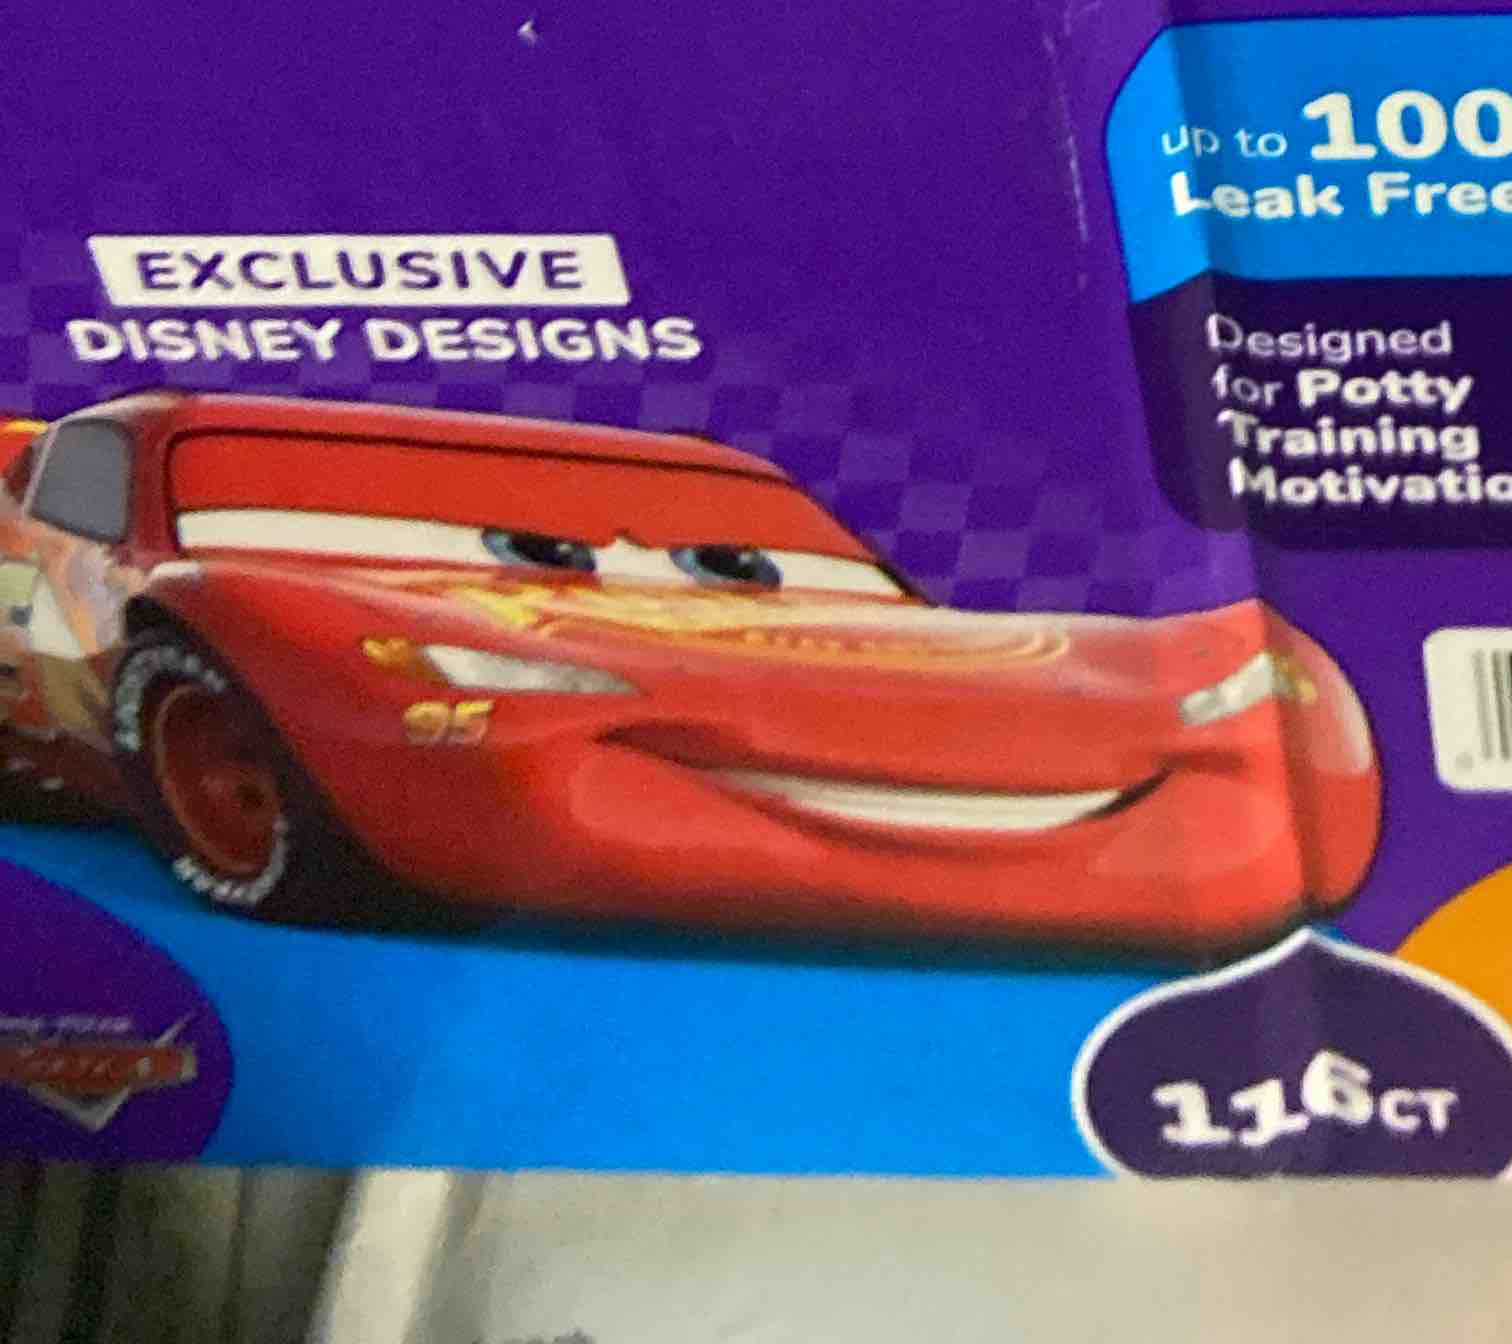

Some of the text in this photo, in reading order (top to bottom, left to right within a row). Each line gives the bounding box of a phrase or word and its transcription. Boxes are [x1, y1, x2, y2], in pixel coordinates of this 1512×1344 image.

[1160, 124, 1220, 159] up
[1235, 123, 1288, 159] to
[1168, 170, 1344, 219] Leak
[135, 249, 586, 292] EXCLUSIVE
[66, 316, 703, 363] DISNEY DESIGNS
[1205, 312, 1453, 364] Designed
[1211, 365, 1475, 413] for Potty
[1216, 409, 1482, 463] Training
